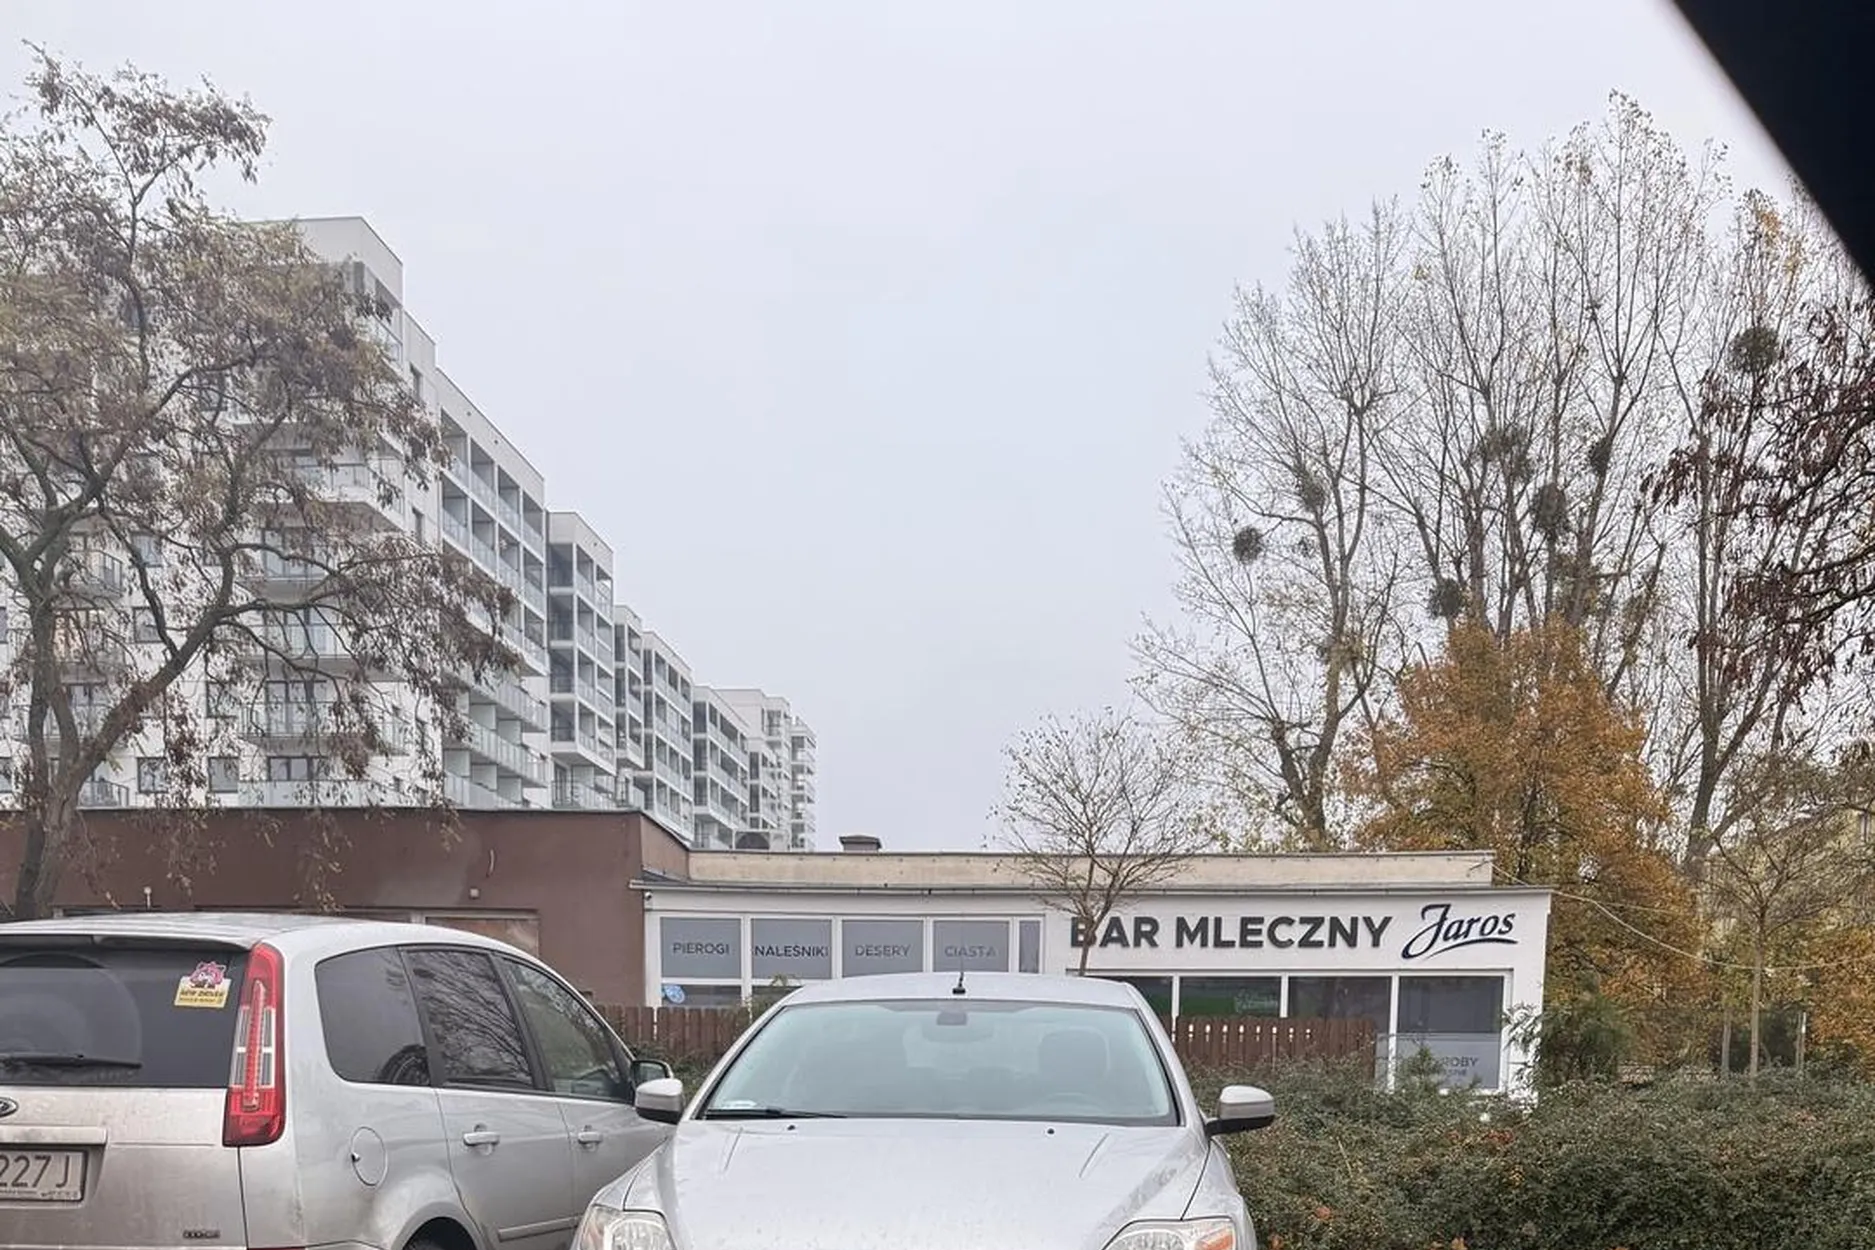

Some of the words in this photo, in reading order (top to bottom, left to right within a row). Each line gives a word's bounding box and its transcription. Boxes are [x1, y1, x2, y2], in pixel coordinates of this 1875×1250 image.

[1071, 916, 1159, 948] BAR
[1175, 916, 1393, 948] MLECZNY
[1401, 903, 1518, 960] Jaros
[673, 942, 730, 955] PIEROGI
[854, 944, 911, 957] DESERY
[944, 945, 997, 958] CIASTA
